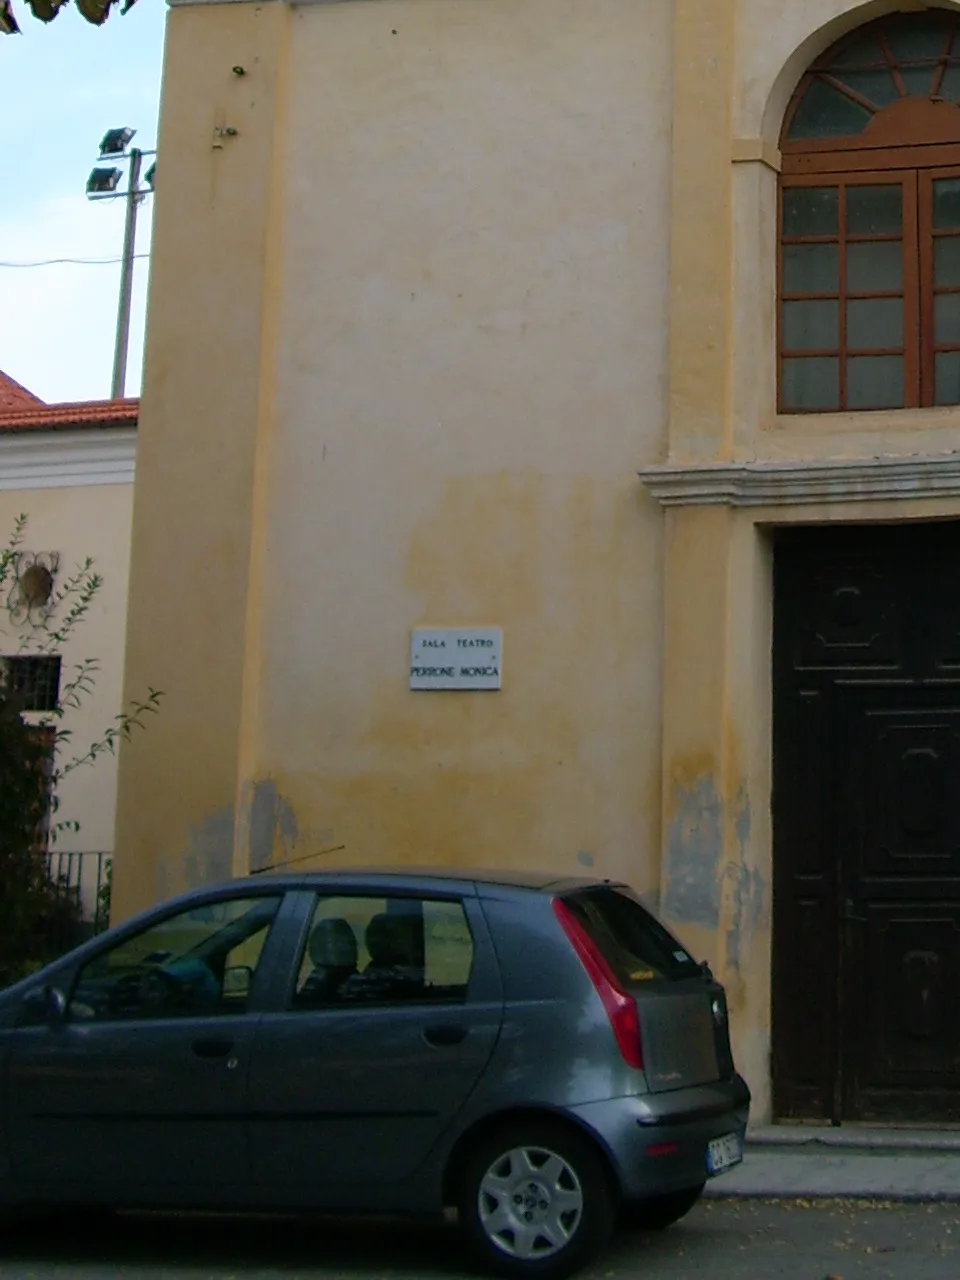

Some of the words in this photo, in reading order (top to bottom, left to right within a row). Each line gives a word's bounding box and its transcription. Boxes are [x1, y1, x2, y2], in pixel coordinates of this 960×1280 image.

[422, 639, 446, 648] SALA
[457, 639, 494, 648] TEATRO
[411, 666, 455, 677] PERRONE
[460, 666, 499, 676] MONICA
